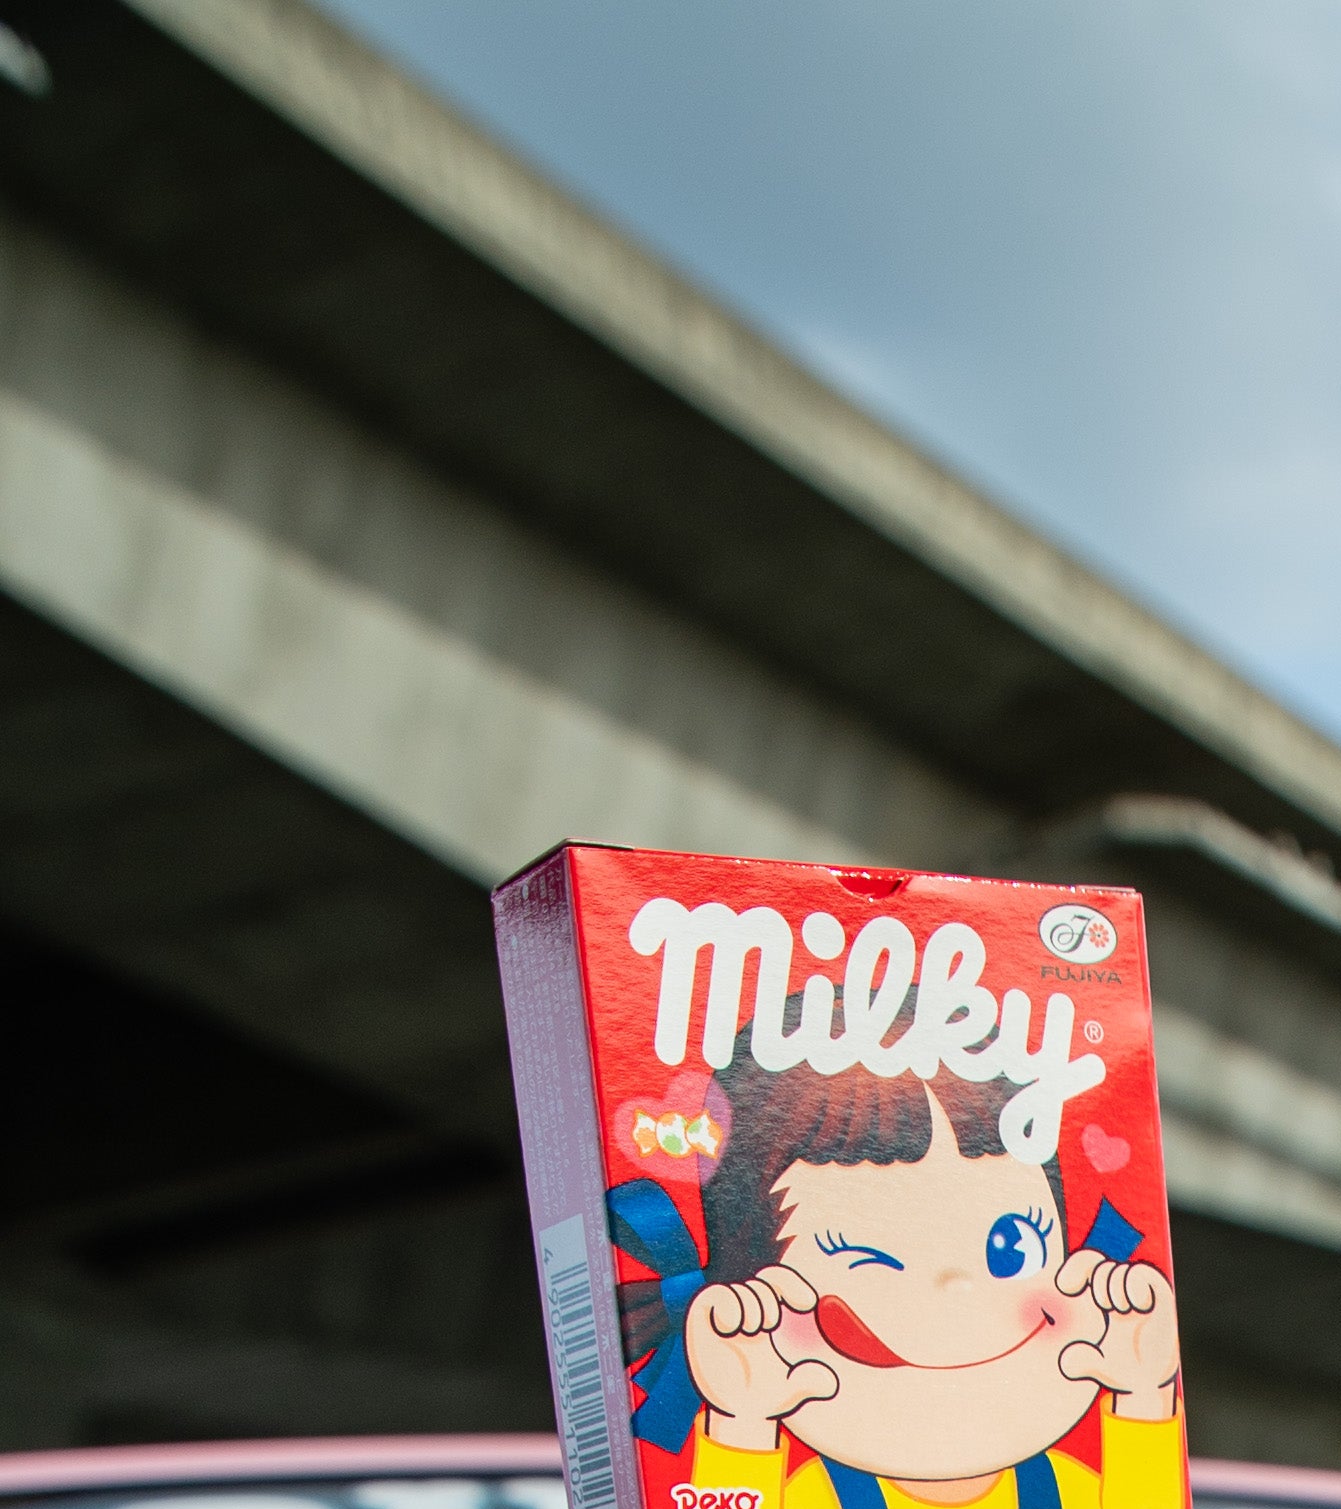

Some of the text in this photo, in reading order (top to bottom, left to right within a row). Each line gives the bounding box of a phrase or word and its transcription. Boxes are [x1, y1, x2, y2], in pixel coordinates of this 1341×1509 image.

[629, 897, 1106, 1165] Milky
[1040, 965, 1122, 985] FUJIYA
[548, 1288, 569, 1411] 902555
